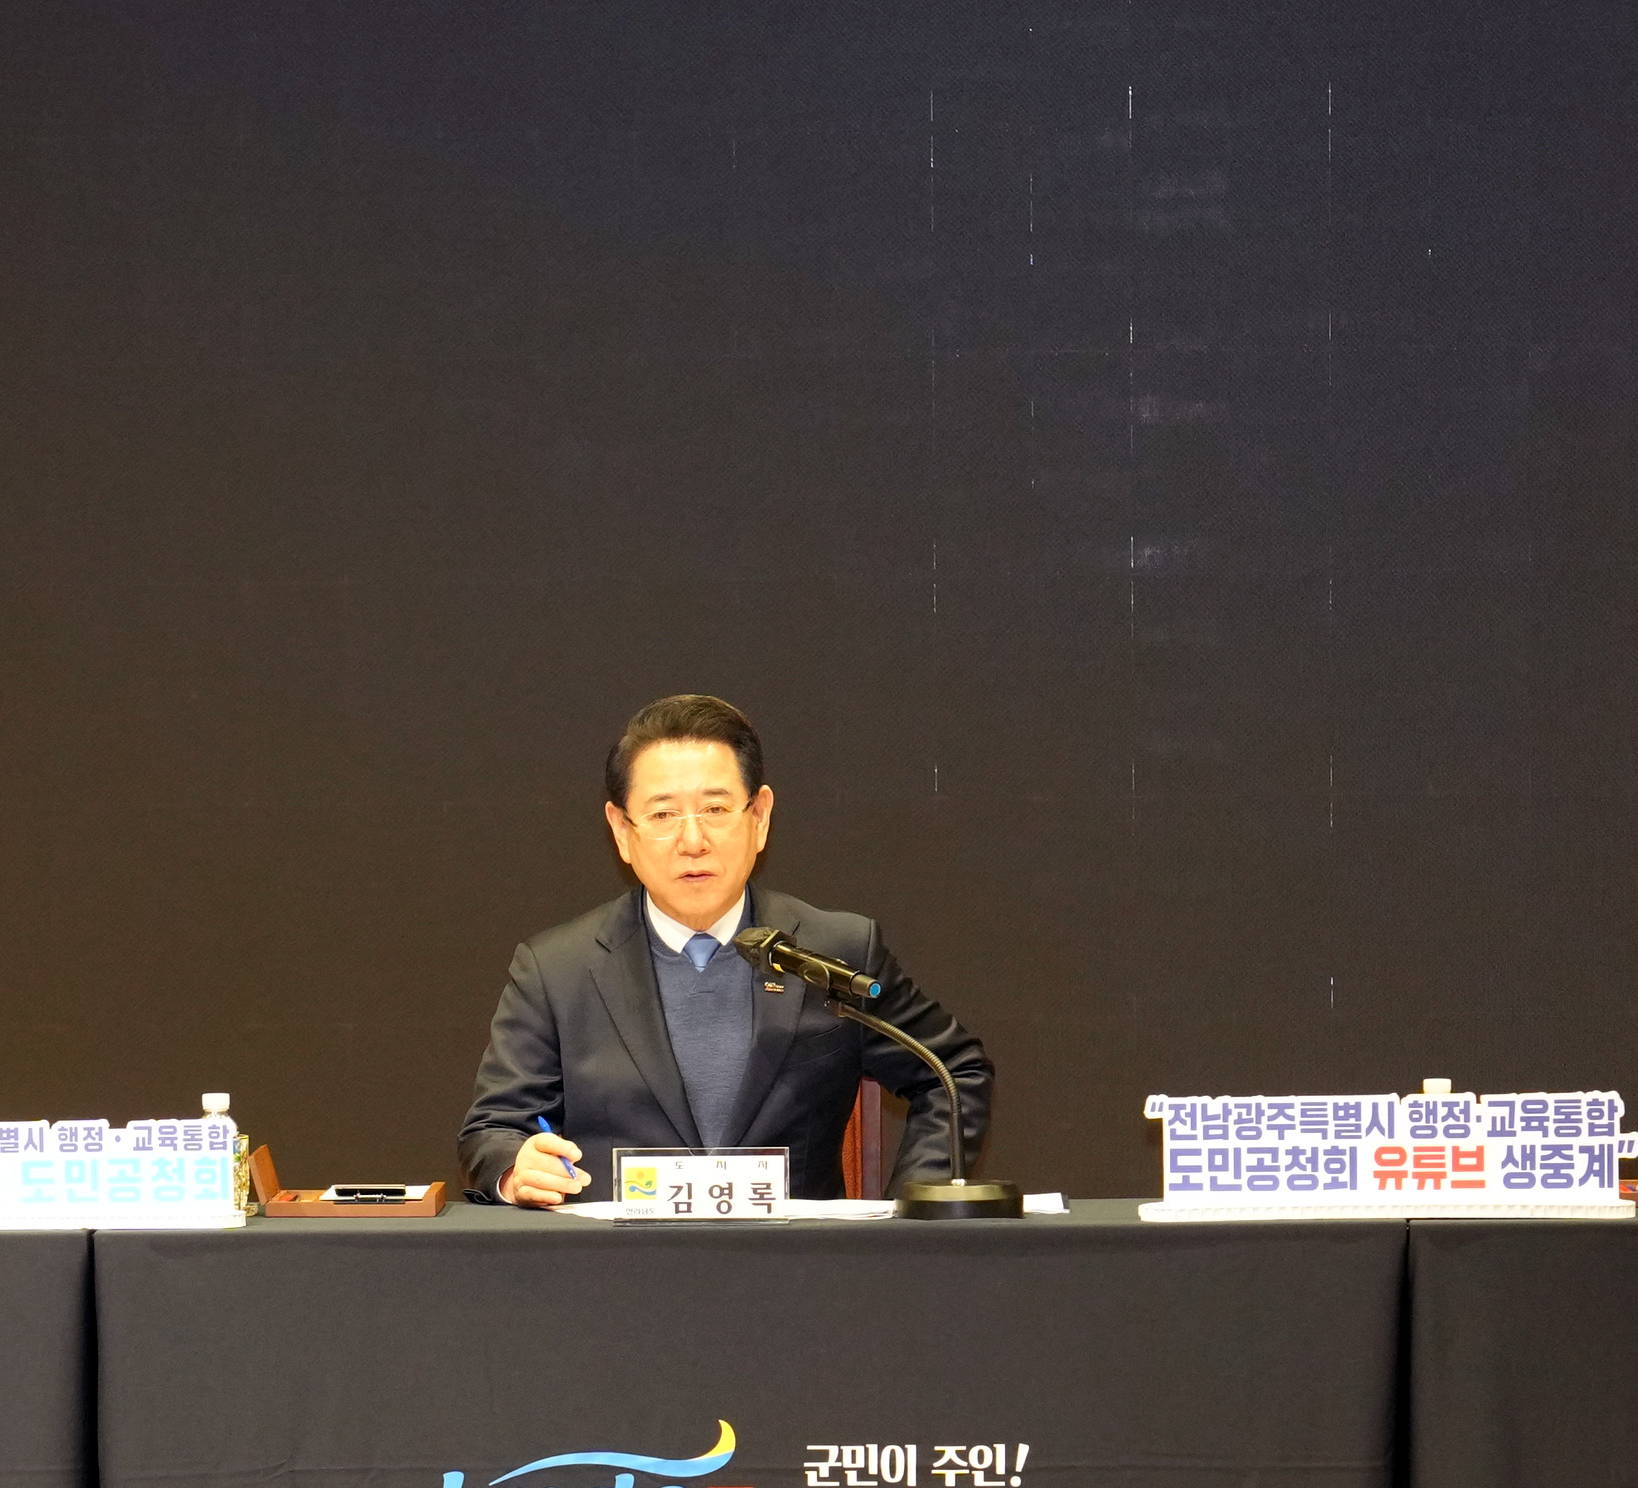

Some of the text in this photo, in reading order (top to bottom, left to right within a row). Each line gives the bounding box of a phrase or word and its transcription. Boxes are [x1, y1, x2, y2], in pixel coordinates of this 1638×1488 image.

[20, 1155, 231, 1204] 도민공청회
[1167, 1145, 1359, 1192] 도민공청회
[1372, 1144, 1487, 1191] 유튜브
[803, 1442, 1030, 1488] 군민이 주인!
